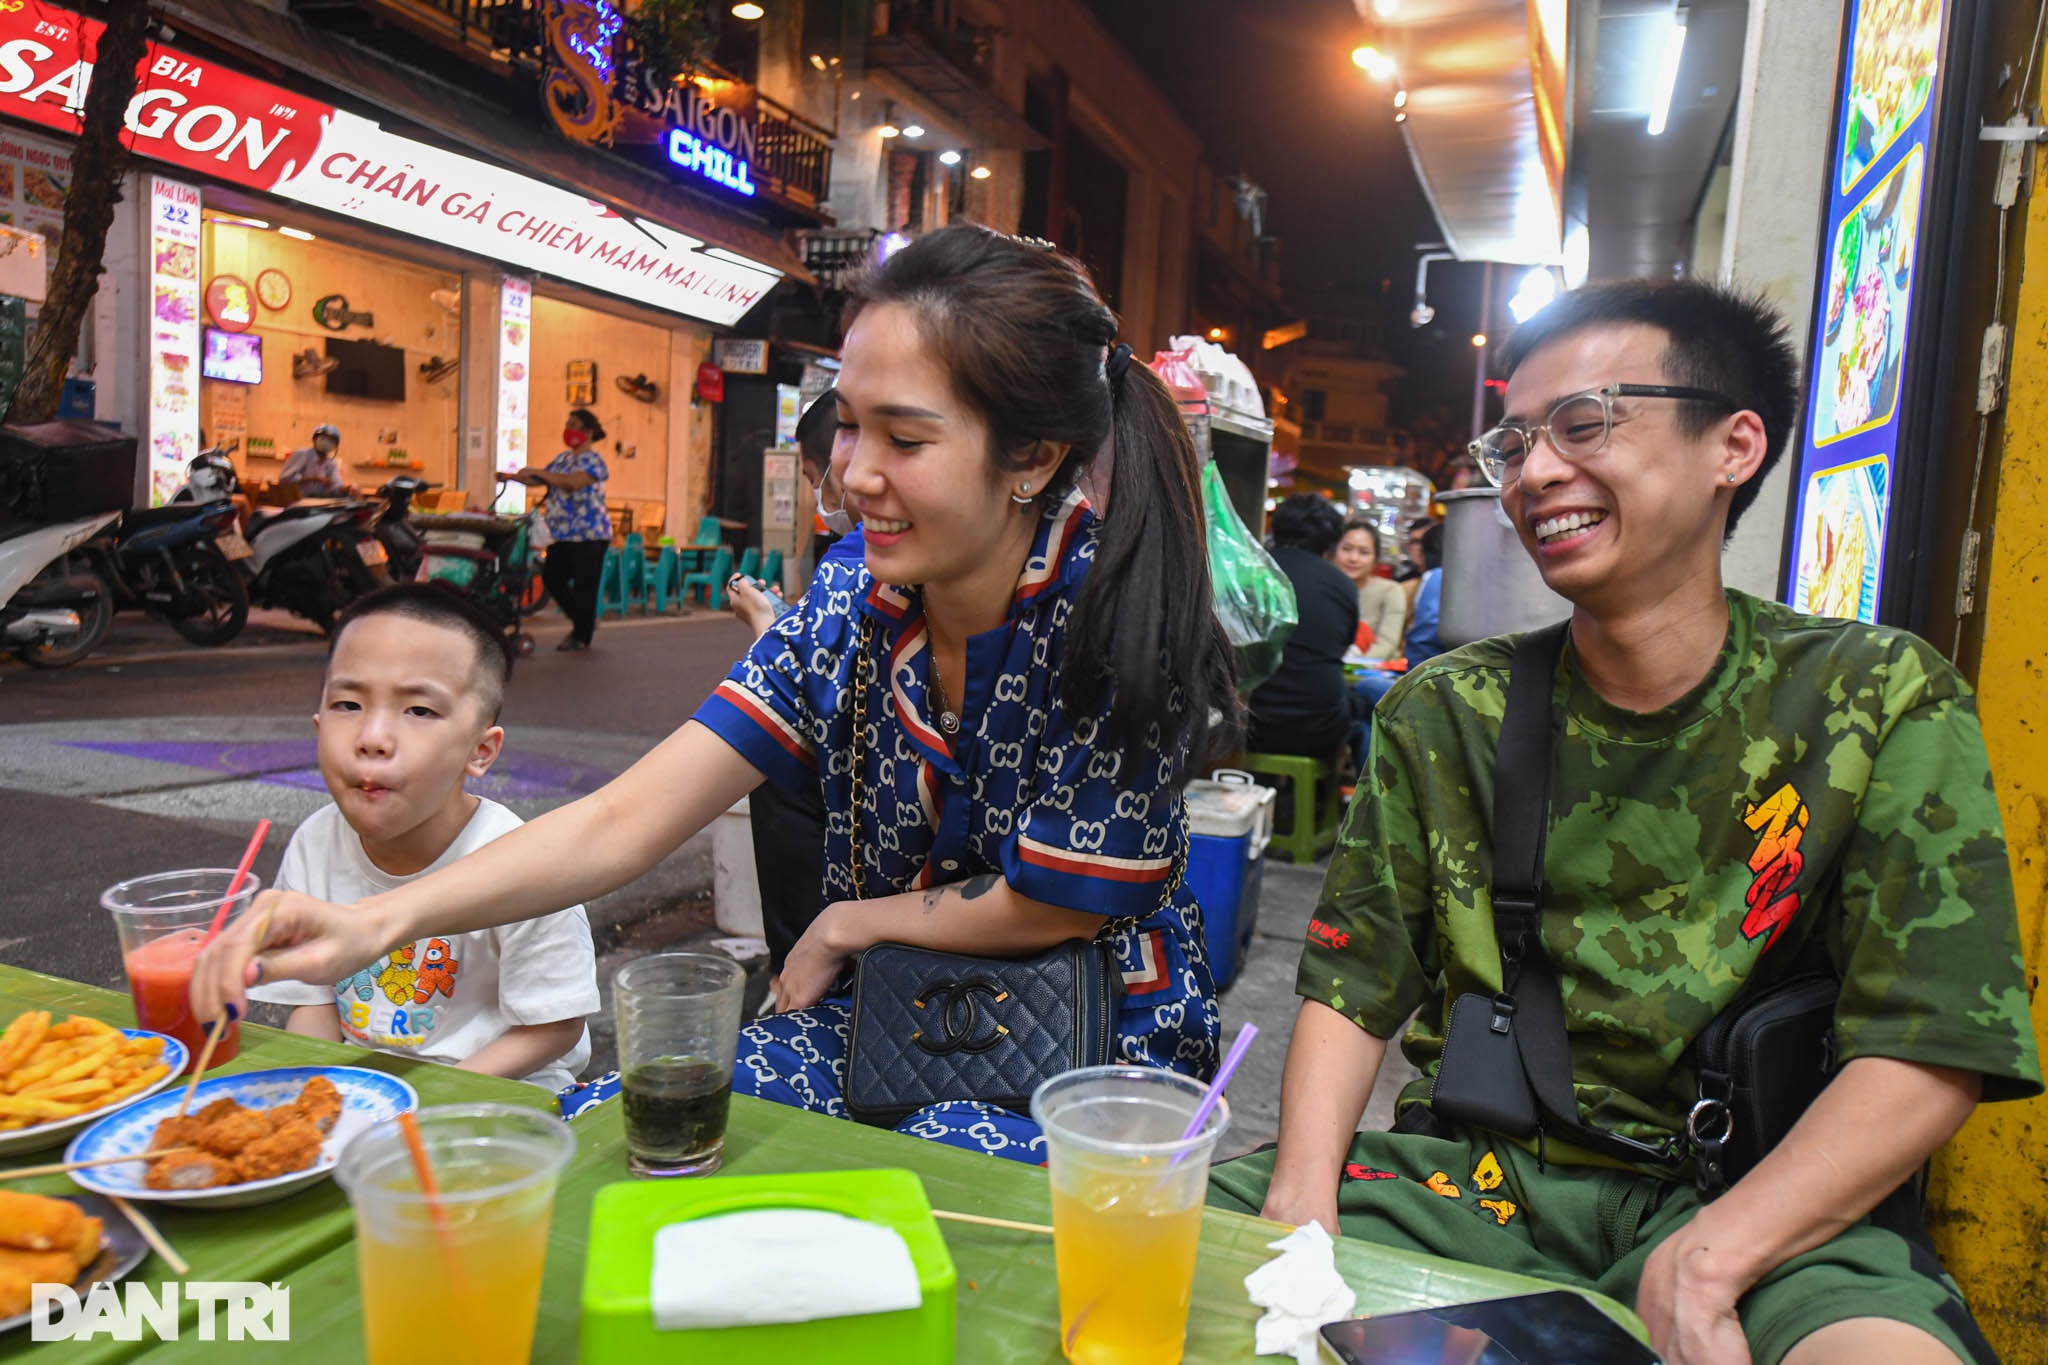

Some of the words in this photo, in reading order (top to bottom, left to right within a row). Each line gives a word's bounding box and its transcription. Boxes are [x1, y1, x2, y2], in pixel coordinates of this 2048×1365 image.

[34, 20, 69, 42] EST.
[0, 39, 291, 171] SAGON
[150, 54, 203, 88] BIA
[644, 67, 758, 163] SAIGON
[668, 127, 756, 197] CHILL
[163, 204, 189, 225] 22
[319, 152, 441, 207] CHÂN
[656, 262, 707, 290] MAI
[703, 277, 761, 307] LINH
